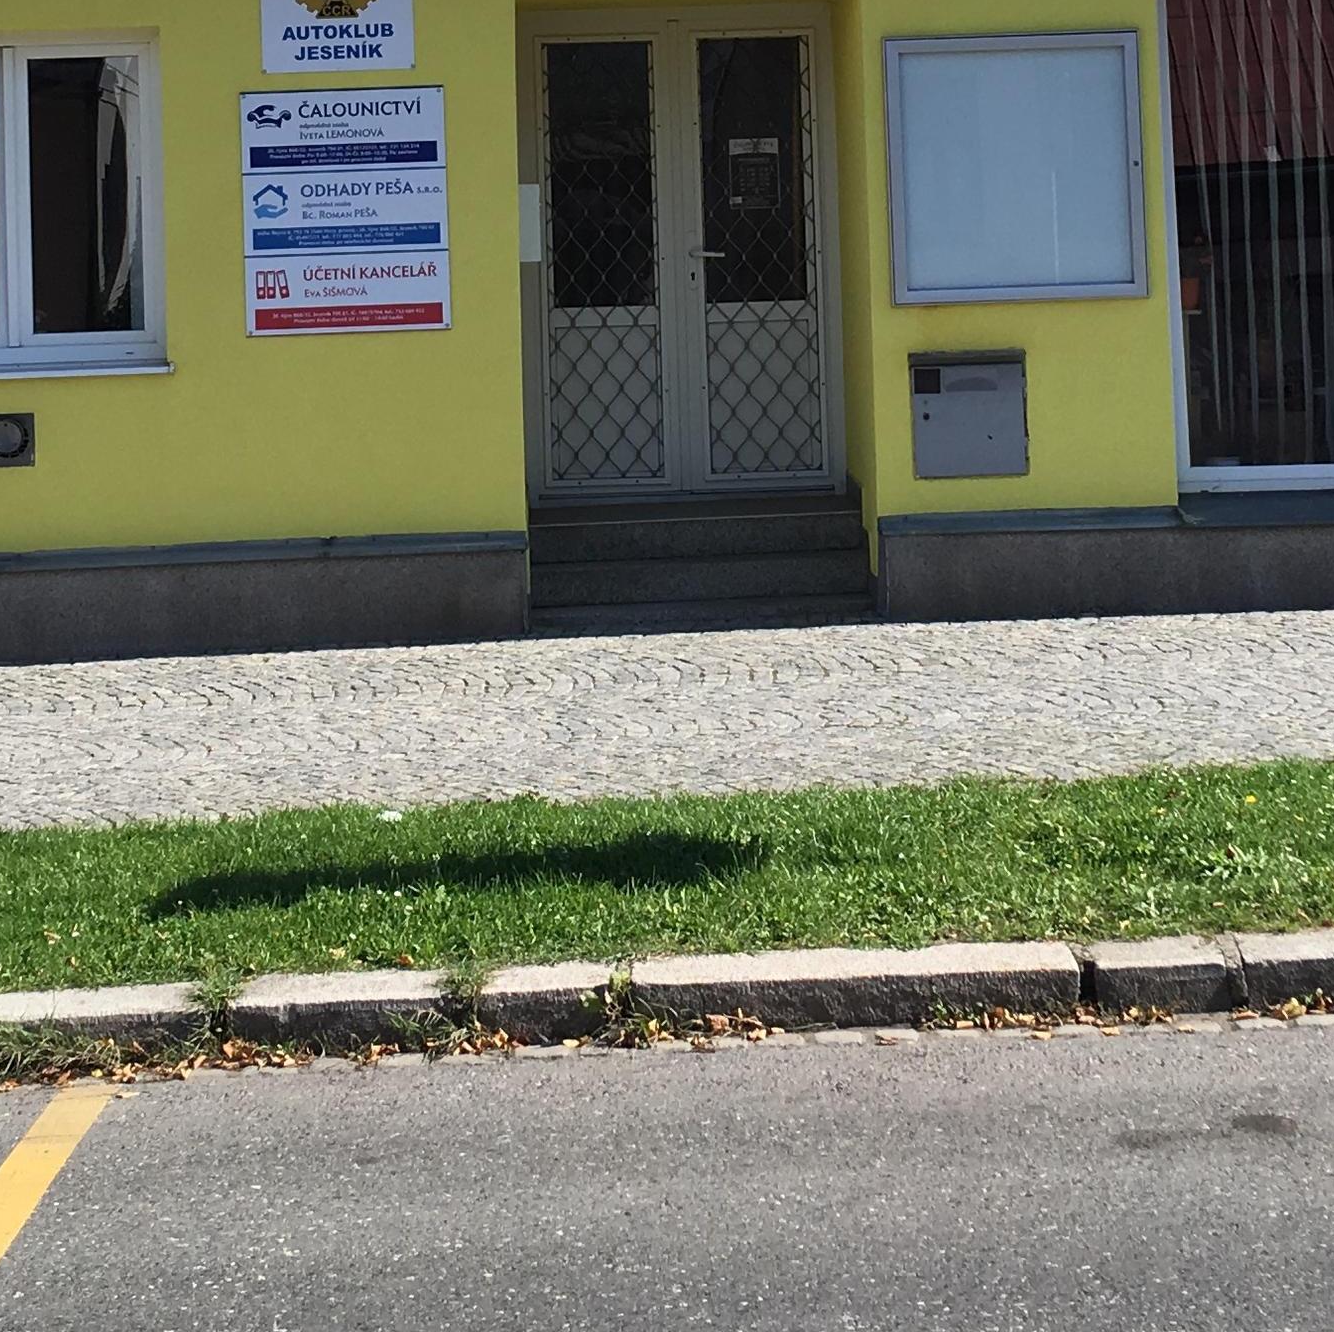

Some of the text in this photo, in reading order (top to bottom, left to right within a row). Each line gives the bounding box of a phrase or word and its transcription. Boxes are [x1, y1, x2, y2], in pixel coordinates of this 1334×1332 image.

[282, 23, 394, 42] AUTOKLUB
[294, 41, 383, 61] JESENÍK
[298, 96, 421, 118] ČALOUNICTVÍ
[326, 127, 385, 139] LEMONOVÁ
[300, 181, 372, 198] ODHADY
[375, 178, 414, 195] PEŠA
[355, 207, 379, 218] PEŠA
[303, 261, 438, 282] ÚČETNÍ KANCELÁŘ
